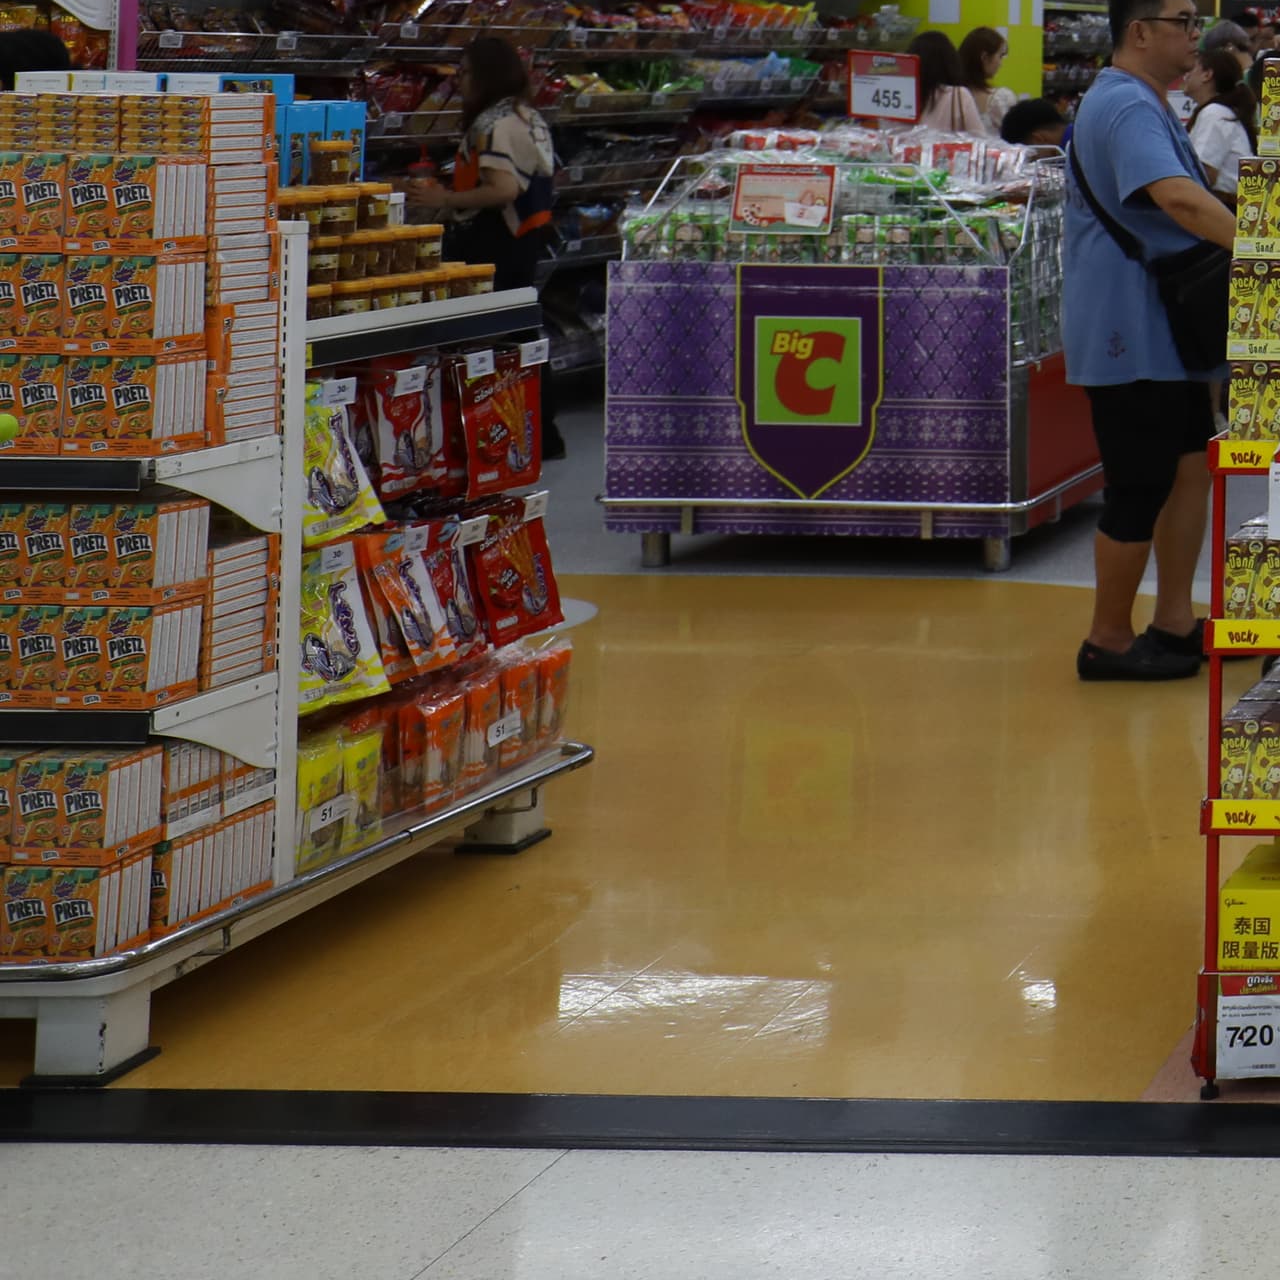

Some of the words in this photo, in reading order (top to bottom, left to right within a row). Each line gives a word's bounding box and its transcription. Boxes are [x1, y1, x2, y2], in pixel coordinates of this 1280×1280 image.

[871, 88, 901, 109] 455
[72, 184, 106, 205] PRETZ
[115, 185, 150, 206] PRETZ
[70, 285, 105, 306] PRETZ
[115, 286, 151, 306] PRETZ
[771, 330, 814, 359] Big
[774, 330, 847, 416] C
[70, 385, 105, 406] PRETZ
[115, 385, 149, 406] PRETZ
[72, 535, 107, 556] PRETZ
[116, 535, 151, 556] PRETZ
[63, 638, 99, 658] PRETZ
[109, 638, 145, 658] PRETZ
[496, 724, 505, 737] 51
[21, 792, 56, 813] PRETZ
[64, 791, 102, 814] PRETZ
[321, 805, 333, 820] 51
[7, 899, 44, 922] PRETZ
[53, 900, 91, 923] PRETZ
[1233, 917, 1271, 936] 泰国
